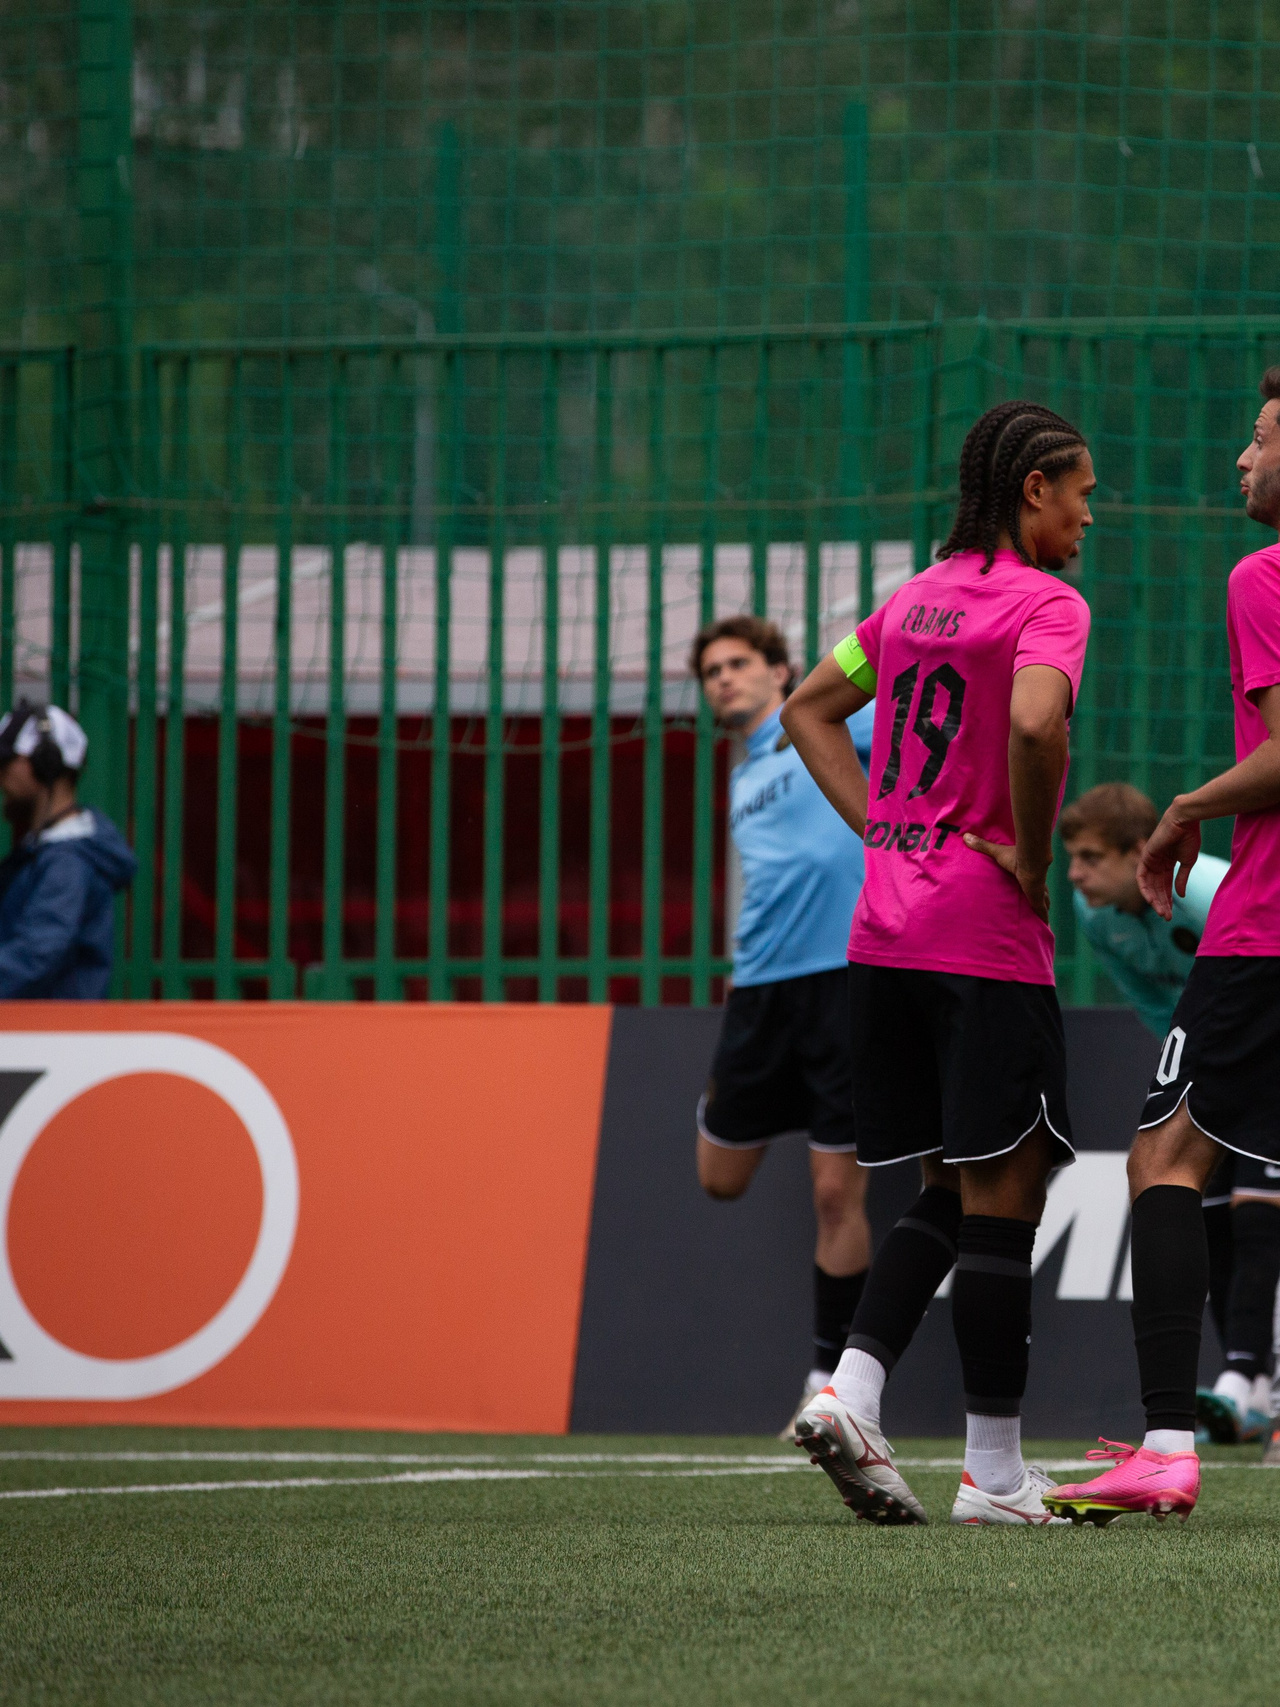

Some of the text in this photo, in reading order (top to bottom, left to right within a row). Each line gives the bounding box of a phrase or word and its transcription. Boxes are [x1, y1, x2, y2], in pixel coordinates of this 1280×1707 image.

[876, 661, 966, 801] 19
[864, 818, 960, 853] ONBT
[1155, 1026, 1187, 1086] 0
